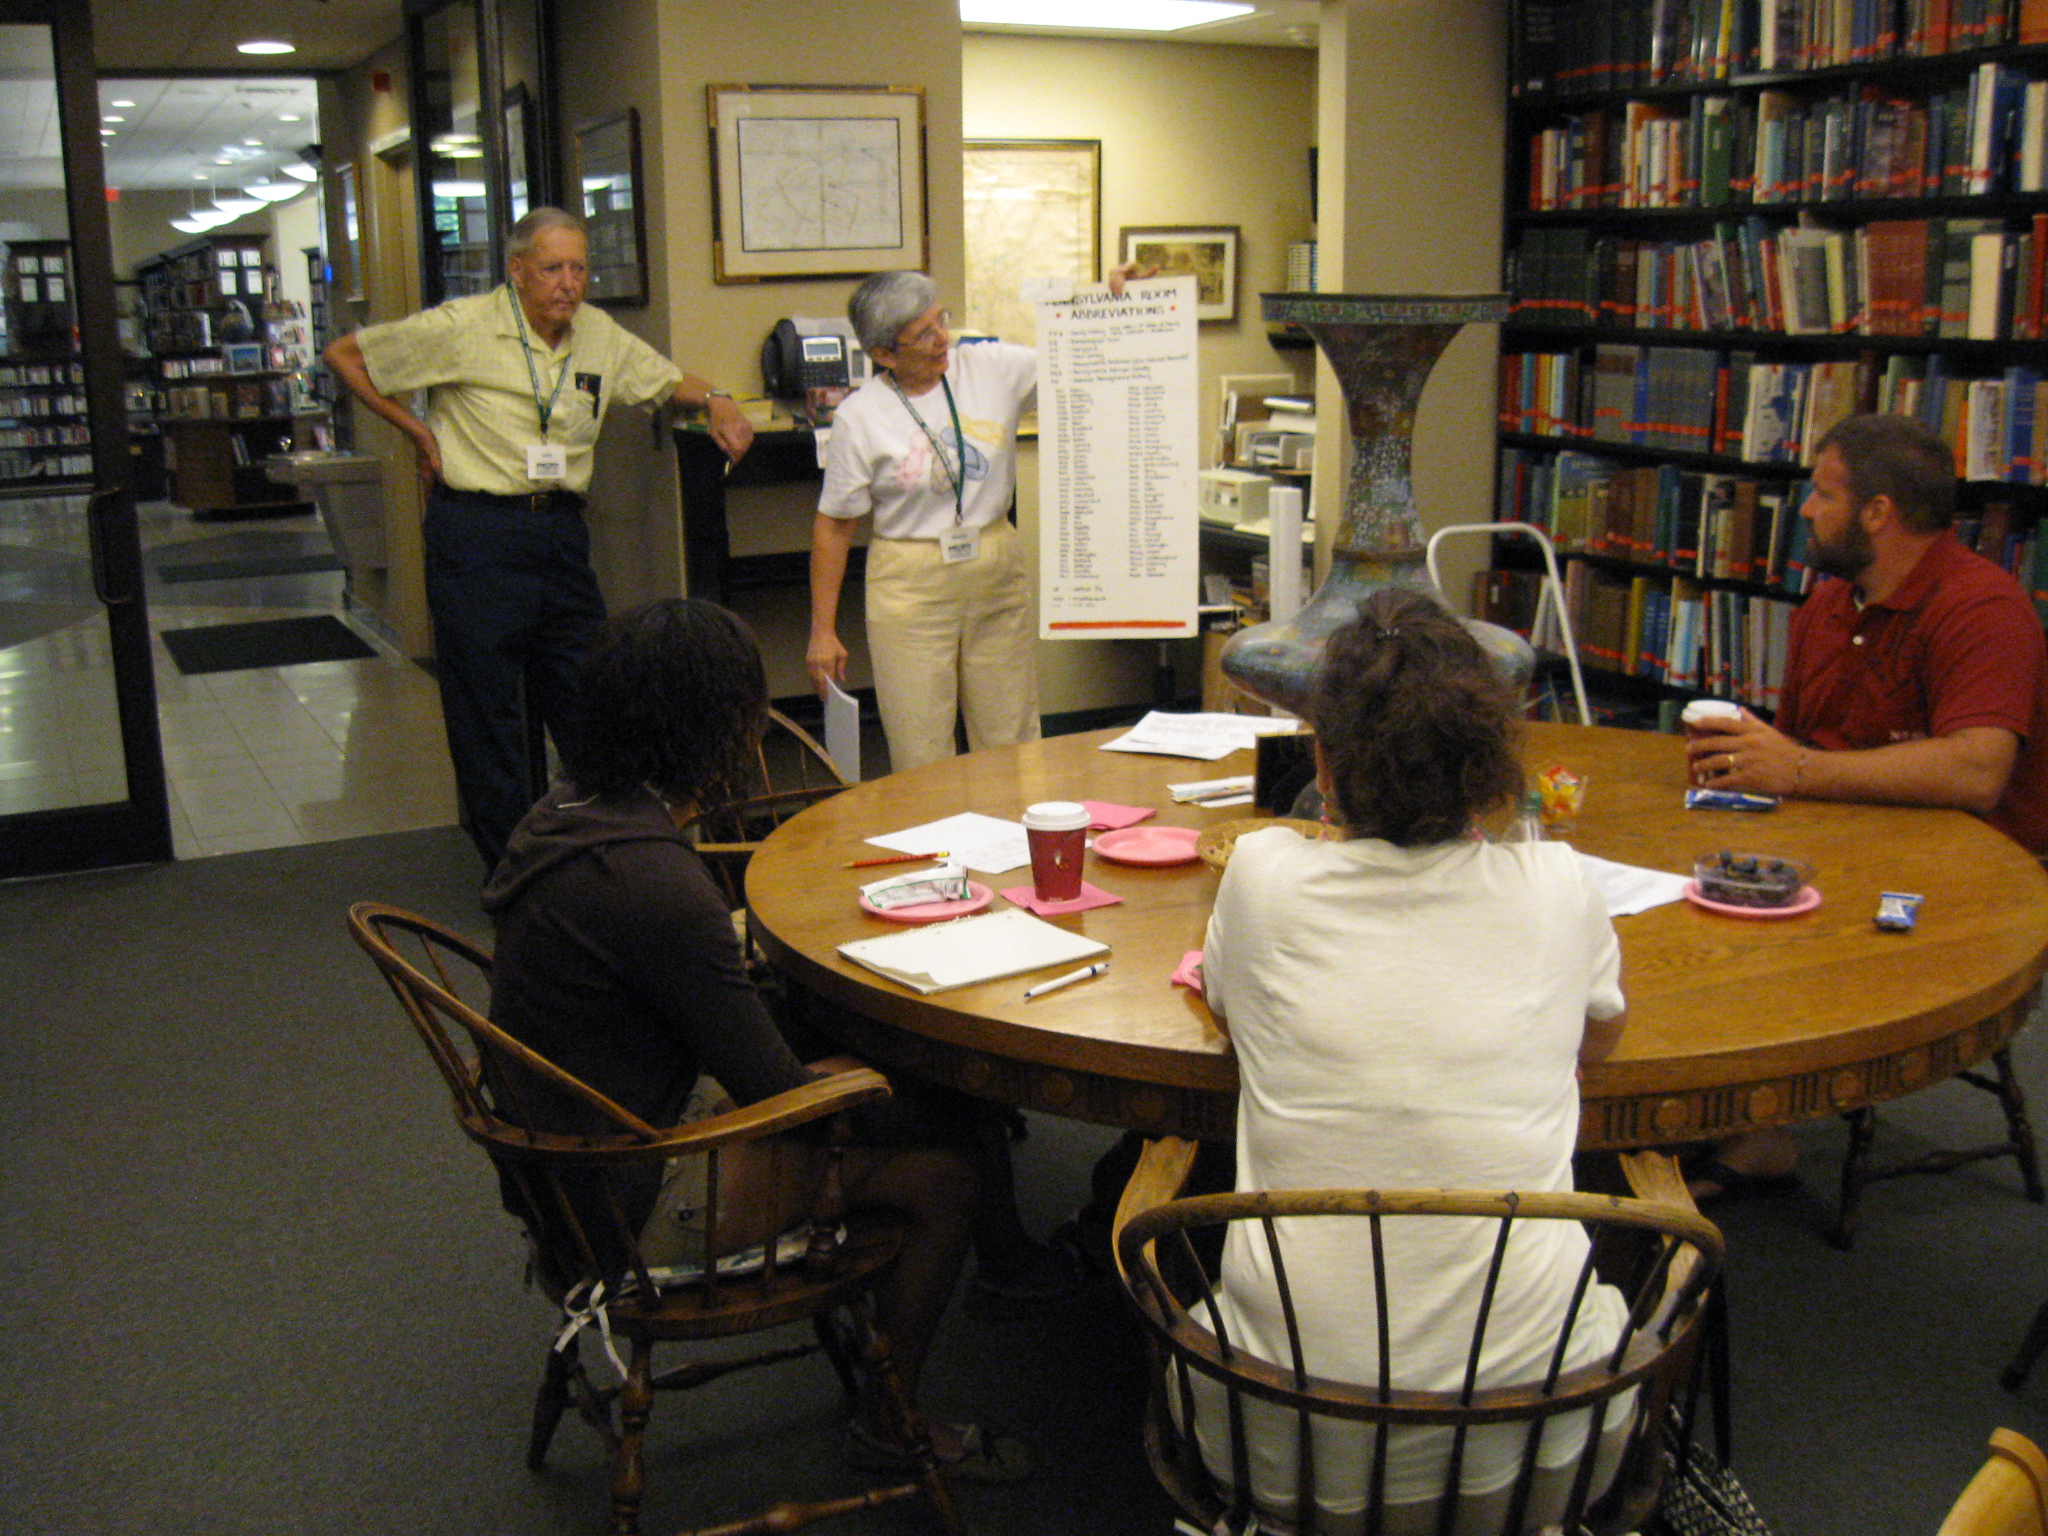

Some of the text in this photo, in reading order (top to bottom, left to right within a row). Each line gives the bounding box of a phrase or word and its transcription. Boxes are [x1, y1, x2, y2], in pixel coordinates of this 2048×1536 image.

[1045, 288, 1177, 306] SYLVANIA ROOM
[1071, 305, 1165, 320] ABBREVIATIONS
